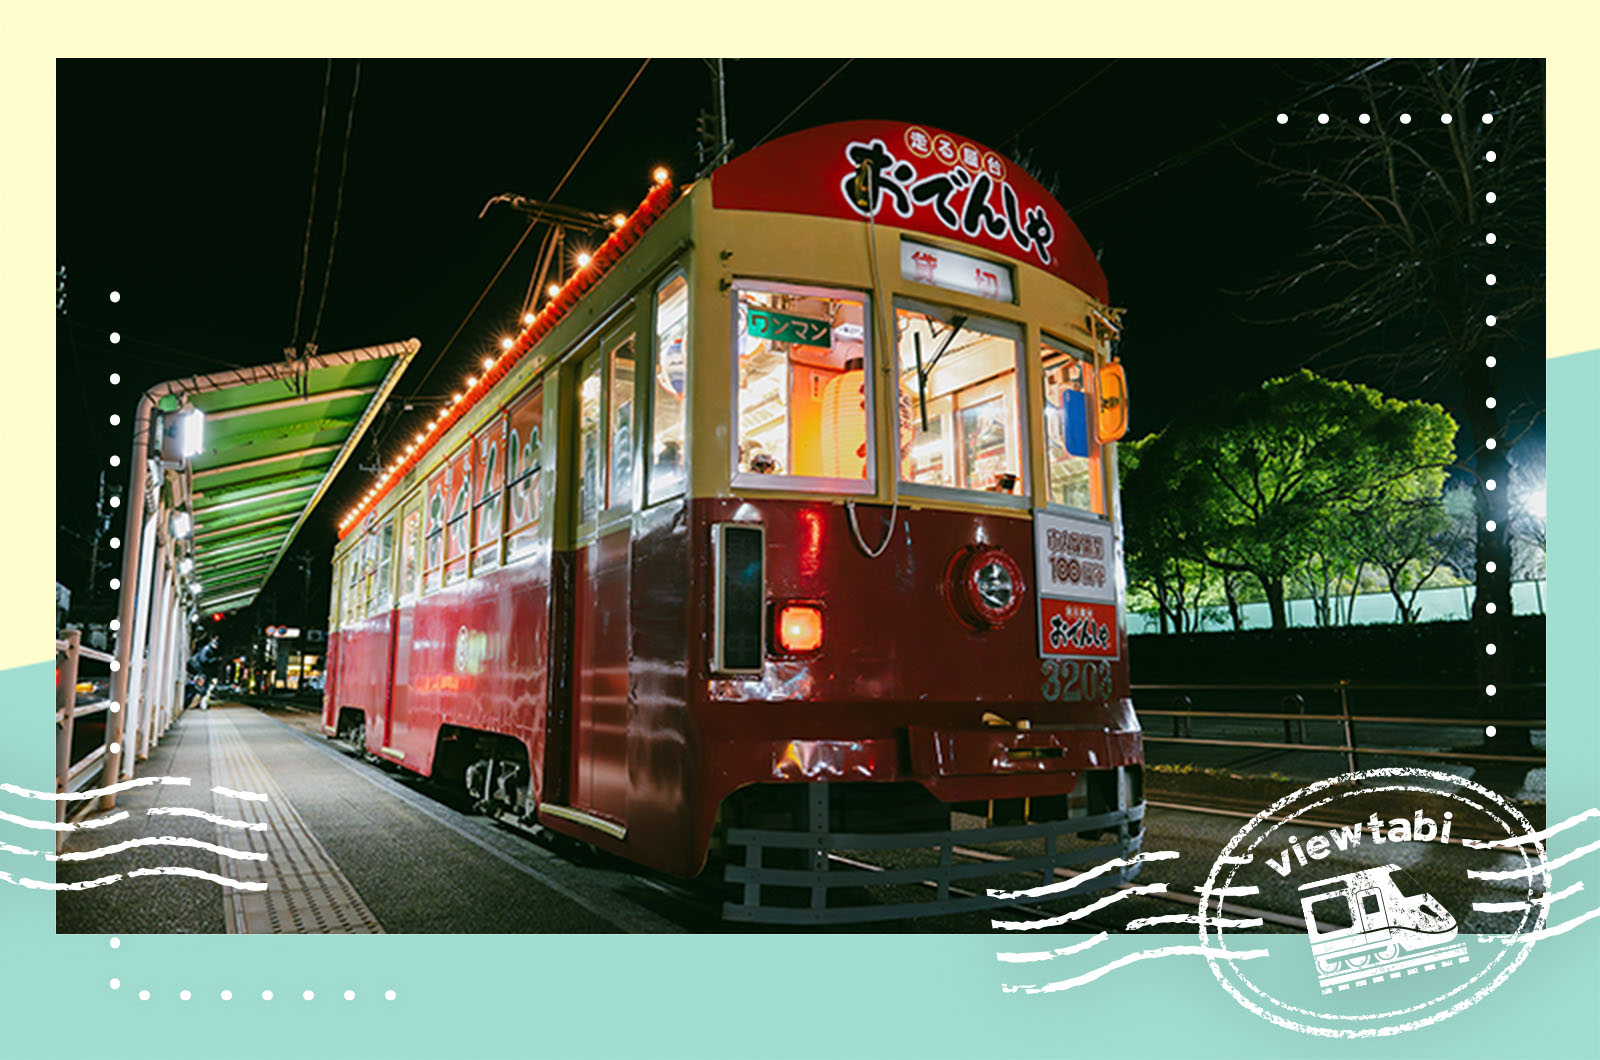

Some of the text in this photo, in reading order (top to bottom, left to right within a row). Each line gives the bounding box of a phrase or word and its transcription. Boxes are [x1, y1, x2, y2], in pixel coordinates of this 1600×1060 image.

[841, 139, 1054, 265] おでんしゃ
[752, 315, 827, 341] ワンマン
